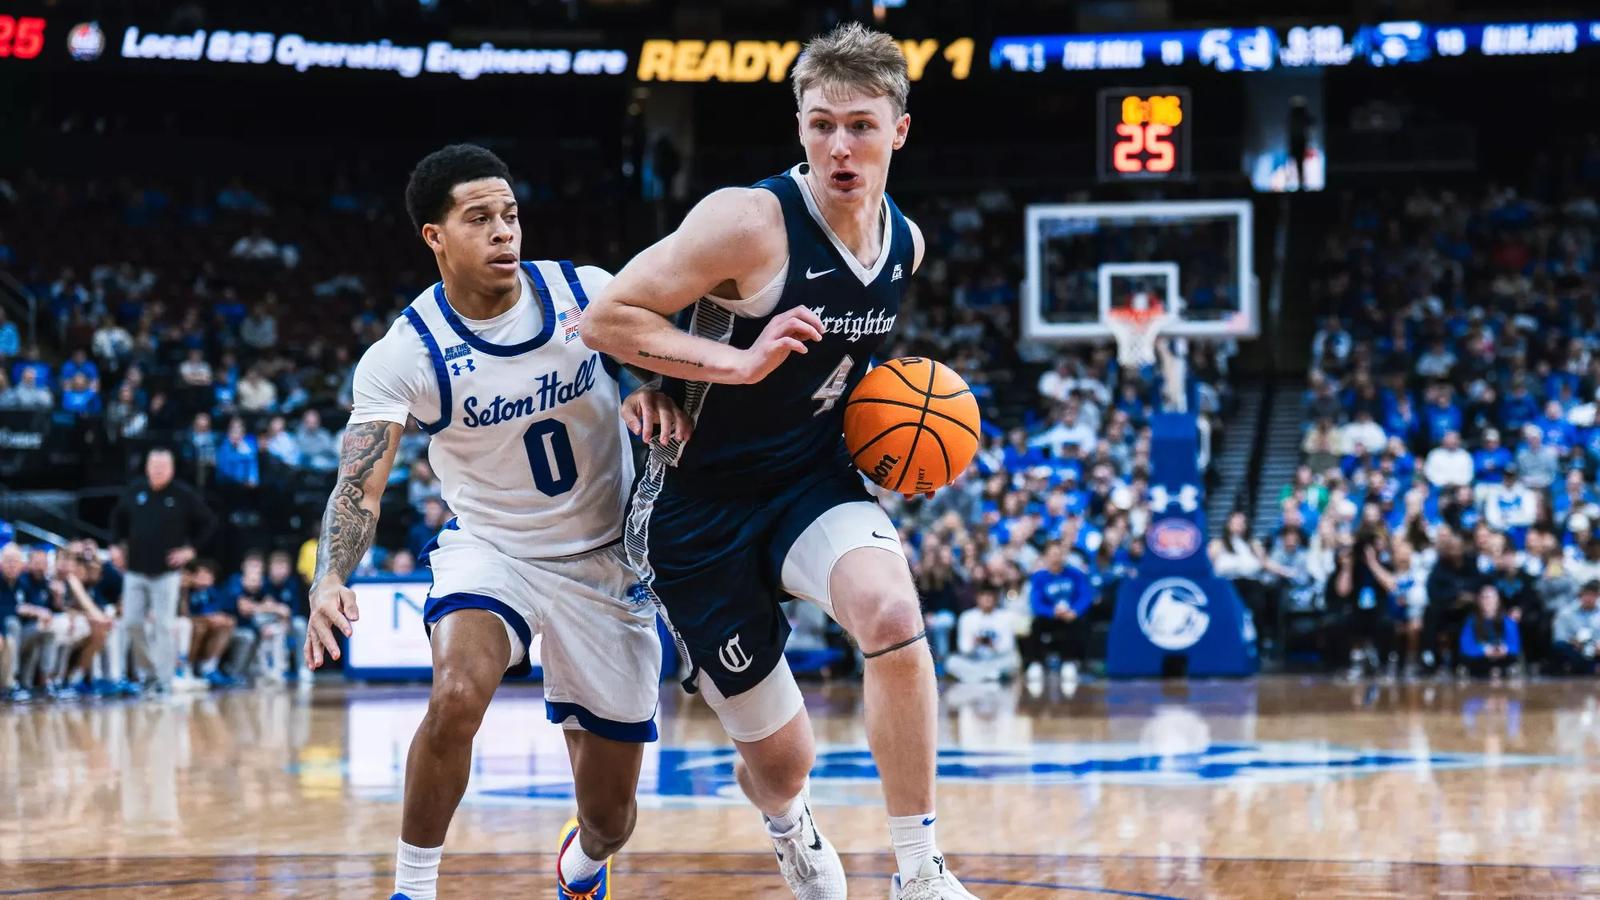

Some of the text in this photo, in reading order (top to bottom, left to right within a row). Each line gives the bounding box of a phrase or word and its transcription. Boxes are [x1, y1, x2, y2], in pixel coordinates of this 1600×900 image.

[121, 26, 206, 60] Local
[276, 34, 423, 78] Operating
[425, 42, 571, 80] Engineers
[573, 50, 627, 75] are
[637, 39, 799, 82] READY
[944, 38, 974, 80] 1
[1114, 124, 1174, 172] 25
[463, 353, 597, 428] Seton Hall
[811, 354, 854, 416] 4
[523, 418, 578, 497] 0
[719, 633, 753, 672] C
